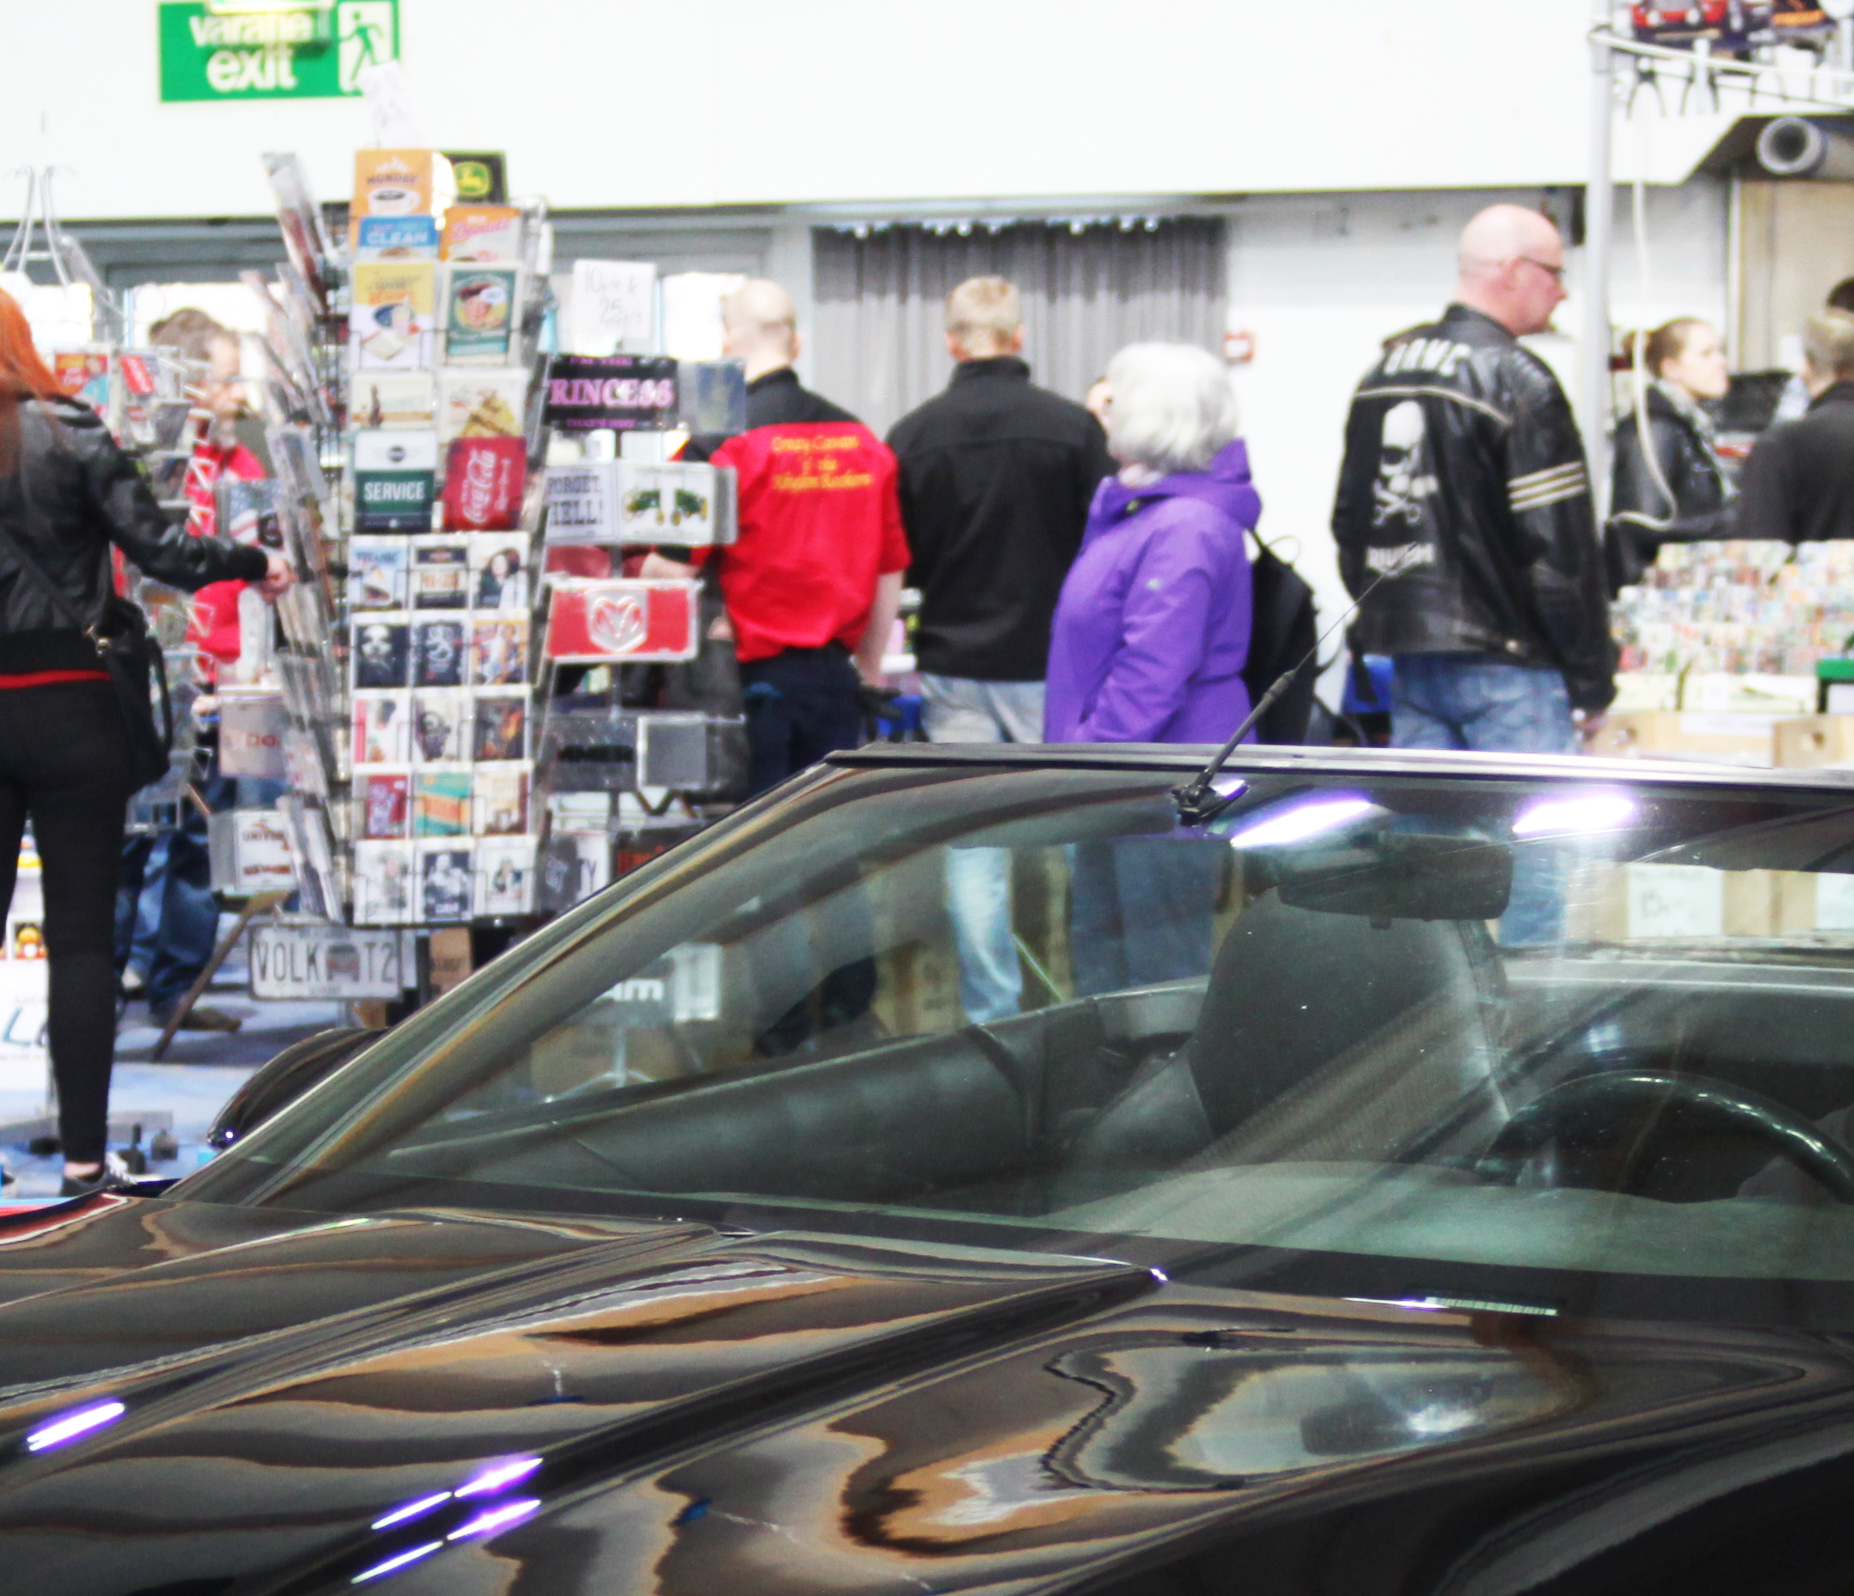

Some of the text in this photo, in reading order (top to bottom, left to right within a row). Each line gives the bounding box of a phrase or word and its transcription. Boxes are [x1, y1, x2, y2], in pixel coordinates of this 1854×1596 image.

[206, 43, 298, 92] exit
[547, 379, 674, 408] RINCESS
[363, 481, 426, 501] SERVICE
[253, 942, 321, 983] VOLK
[363, 942, 396, 983] T2
